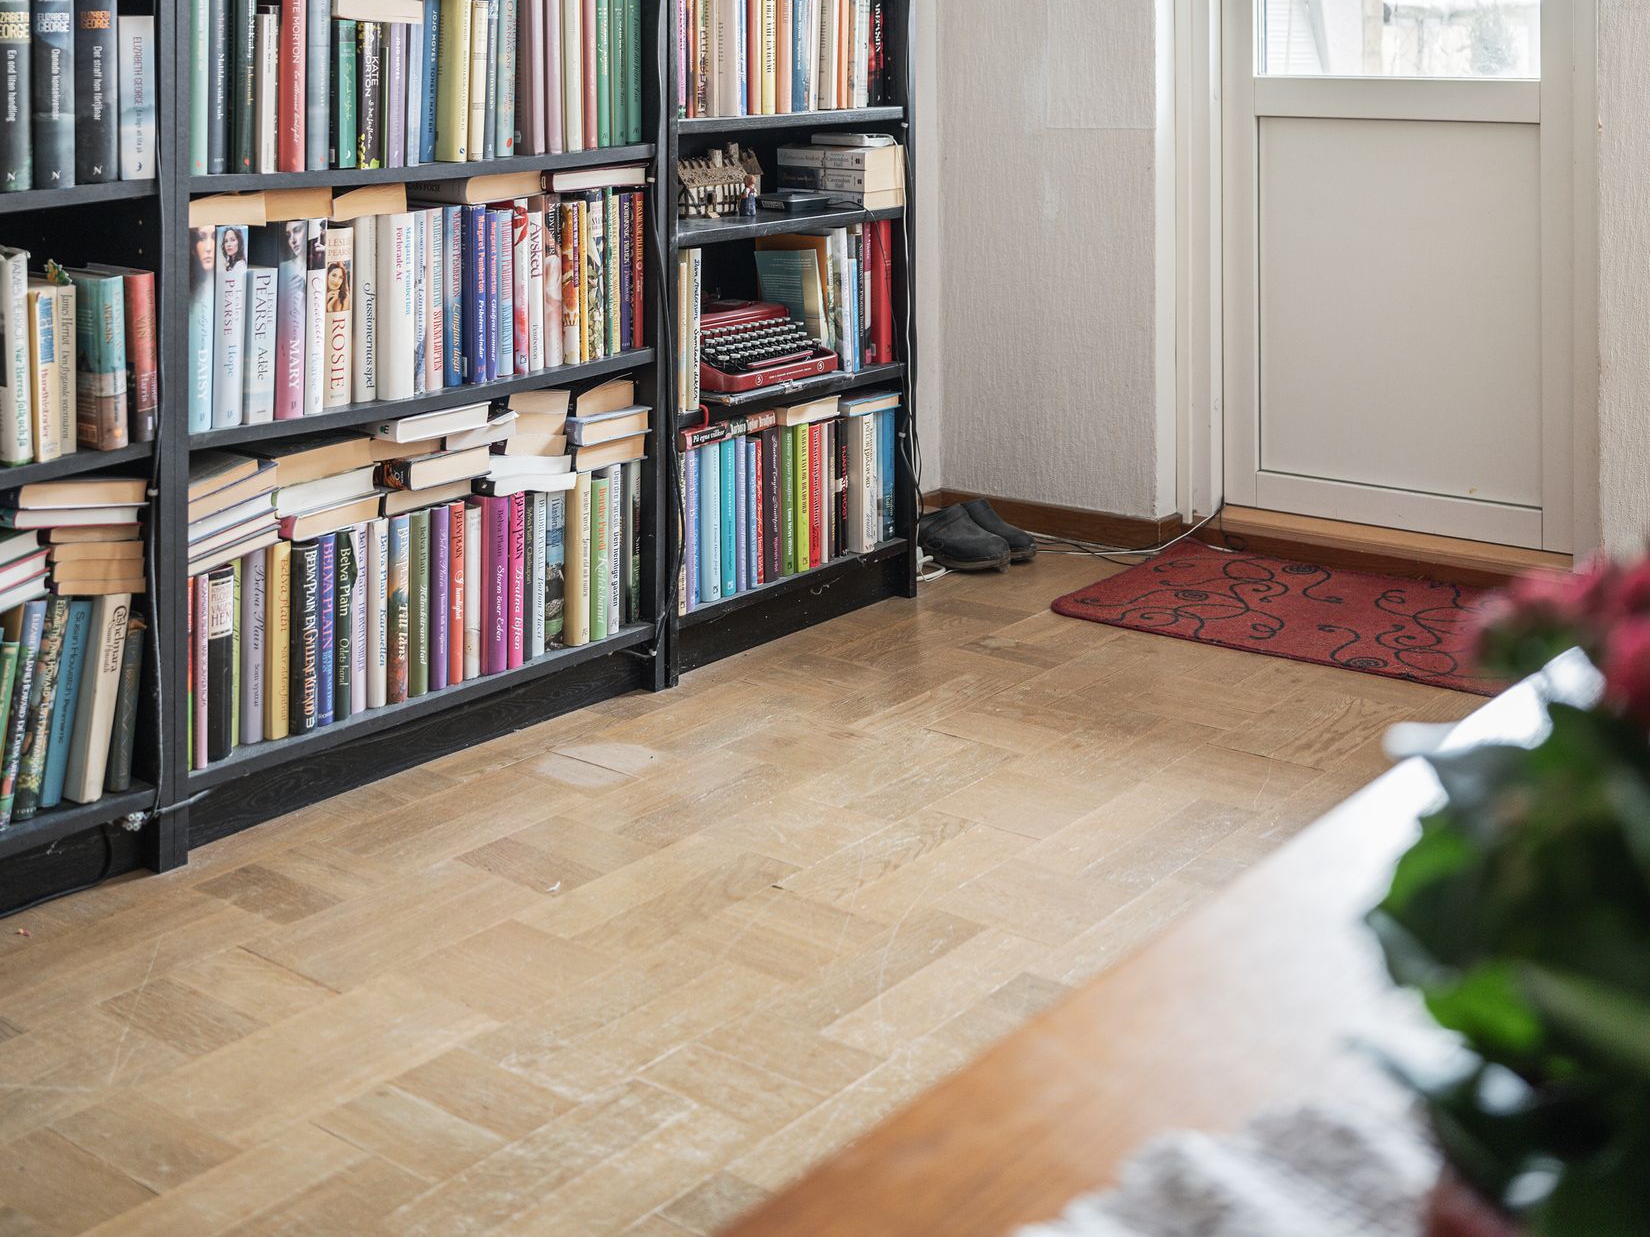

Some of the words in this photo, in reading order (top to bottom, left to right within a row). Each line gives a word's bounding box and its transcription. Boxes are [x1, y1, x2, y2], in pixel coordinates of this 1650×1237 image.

[8, 50, 17, 59] En
[94, 46, 102, 57] Det
[133, 37, 142, 75] ELIZABETH
[292, 16, 300, 64] MORTON
[8, 61, 17, 73] ond
[8, 75, 18, 89] liten
[94, 59, 103, 77] straff
[371, 56, 379, 86] KATE
[94, 79, 102, 91] hon
[6, 92, 18, 122] handling
[92, 93, 103, 120] förtjänar
[452, 212, 461, 252] MARGARET
[477, 216, 485, 250] Margaret
[548, 203, 556, 255] MIDVINTER
[530, 222, 543, 279] Avsked
[453, 253, 461, 298] PEMBERTON
[60, 294, 73, 316] James
[224, 279, 235, 336] PEARSE
[254, 274, 271, 340] PEARSE
[61, 318, 73, 346] Herriot
[363, 282, 376, 365] Passionernas
[227, 345, 237, 378] Hope
[257, 347, 268, 380] Adèle
[289, 339, 300, 389] MARY
[330, 318, 346, 390] ROSIE
[141, 373, 149, 402] Harris
[197, 349, 208, 401] DAISY
[363, 367, 375, 389] spel
[304, 551, 317, 582] BELVA
[322, 542, 333, 594] BELVA
[339, 548, 351, 582] Belva
[496, 565, 504, 594] Storm
[253, 565, 265, 608] Belva
[303, 582, 317, 613] PLAIN
[339, 584, 351, 617] Plain
[379, 570, 387, 600] Plain
[515, 565, 523, 614] Brutna
[595, 555, 608, 624] Kärleksbarnet
[71, 611, 85, 645] Susan
[253, 611, 264, 650] Plain
[303, 616, 316, 630] EN
[321, 596, 333, 650] PLAIN
[398, 603, 408, 628] Till
[496, 618, 504, 642] Eden
[110, 605, 128, 673] Cashelmara
[398, 631, 408, 660] låns
[512, 617, 523, 650] löften
[303, 629, 317, 677] GYLLENE
[65, 648, 81, 697] Howatch
[302, 677, 317, 715] KLENOD
